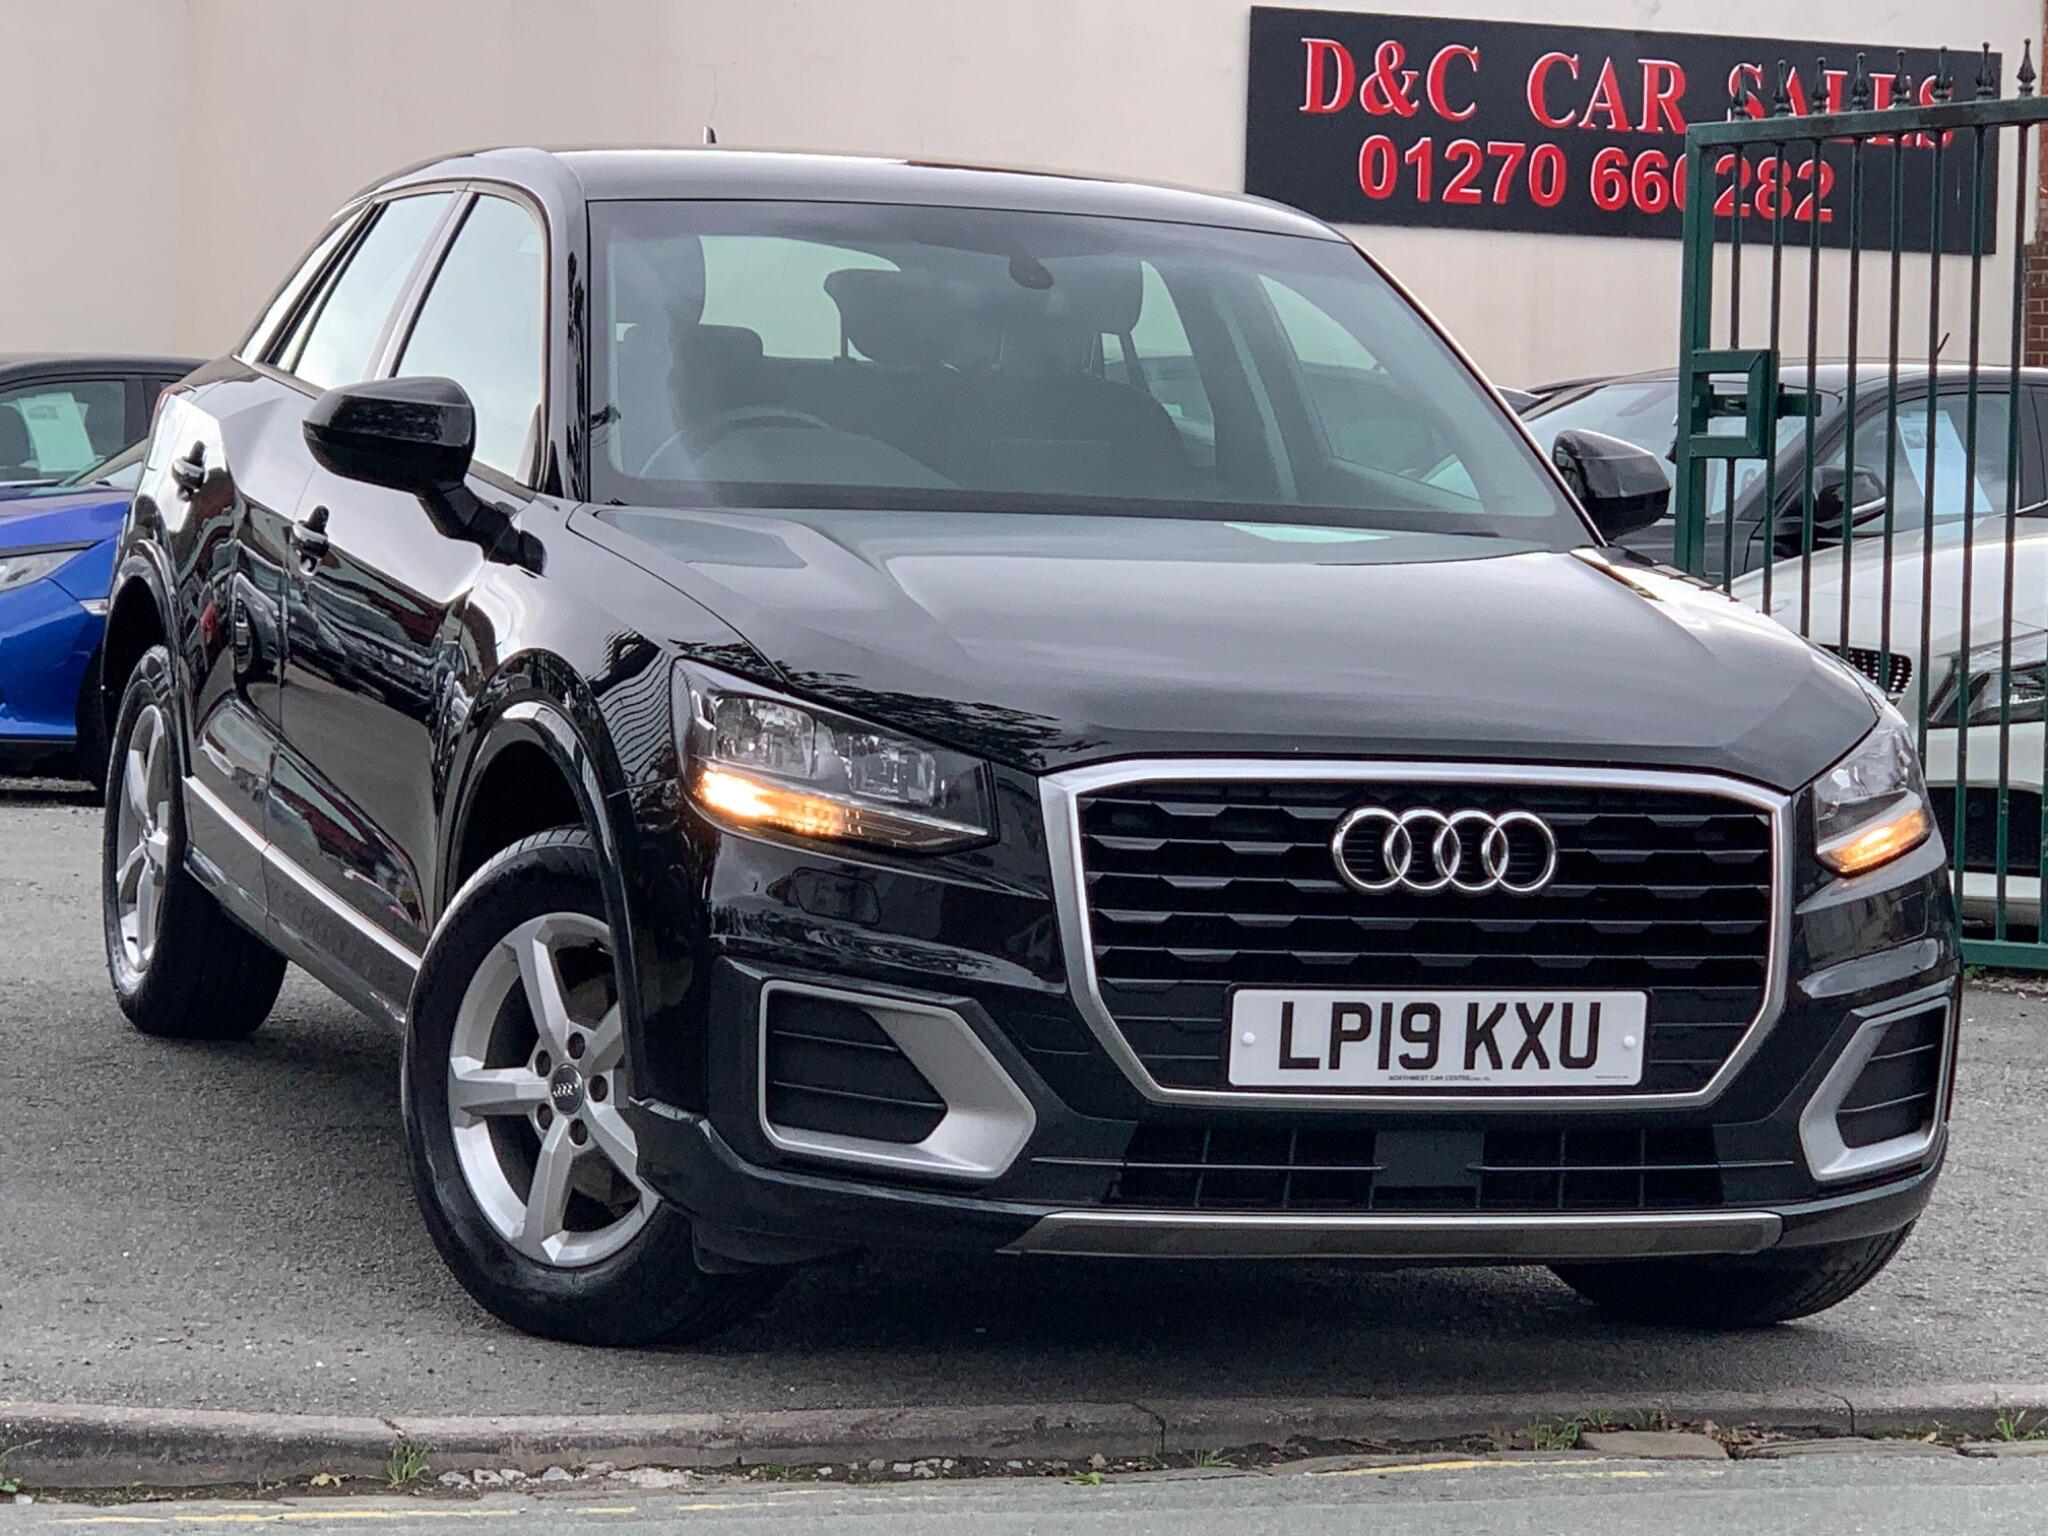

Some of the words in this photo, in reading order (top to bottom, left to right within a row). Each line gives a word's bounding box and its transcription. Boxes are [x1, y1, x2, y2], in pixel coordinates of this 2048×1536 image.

[1300, 37, 1481, 122] D&C
[1526, 51, 1688, 135] CAR
[1358, 134, 1568, 207] 01270
[1713, 154, 1835, 222] 282
[1278, 1001, 1441, 1070] LP19
[1463, 1002, 1602, 1070] KXU
